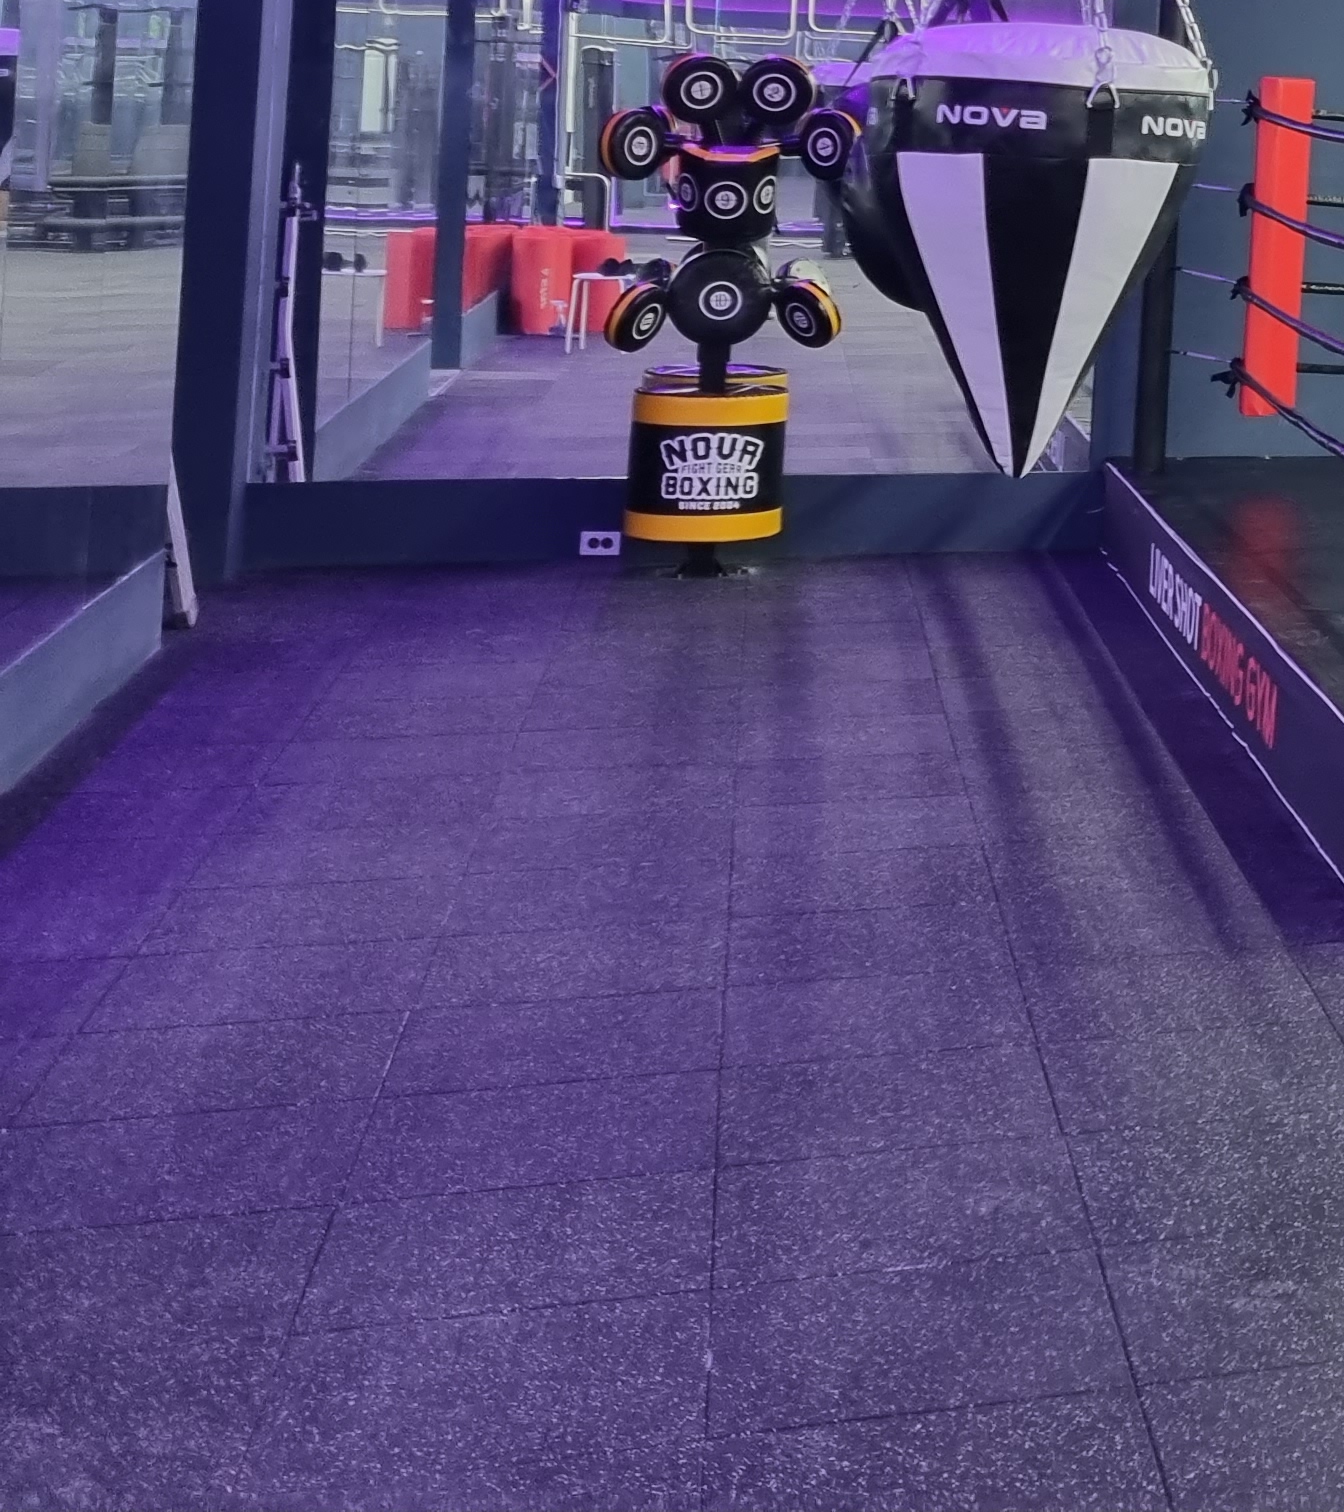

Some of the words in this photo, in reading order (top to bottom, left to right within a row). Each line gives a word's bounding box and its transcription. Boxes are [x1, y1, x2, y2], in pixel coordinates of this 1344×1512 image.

[663, 474, 757, 498] BOXING
[1149, 543, 1175, 622] LIVER
[1173, 573, 1203, 651] SHOT
